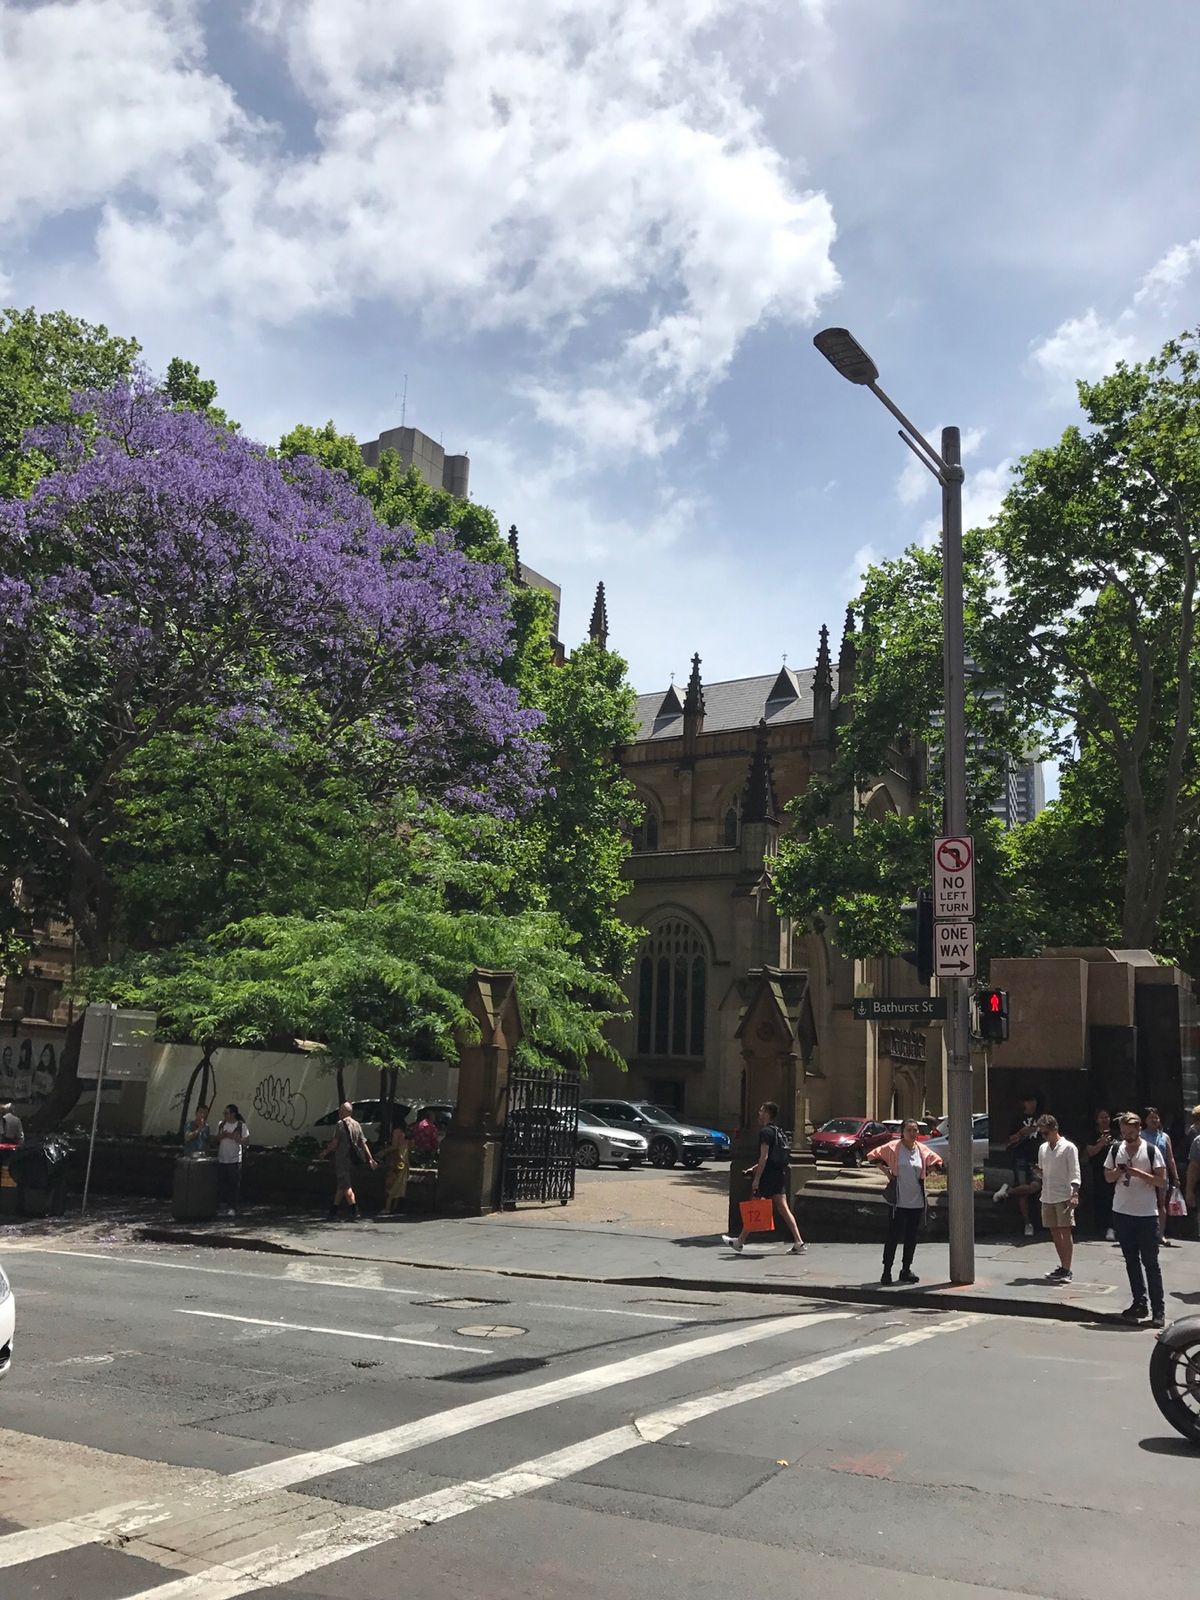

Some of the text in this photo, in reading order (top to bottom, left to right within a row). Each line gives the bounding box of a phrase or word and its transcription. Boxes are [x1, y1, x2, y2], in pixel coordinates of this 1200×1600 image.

[943, 877, 965, 889] NO
[940, 891, 967, 901] LEFT
[940, 903, 969, 912] TURN
[941, 928, 968, 940] ONE
[940, 944, 969, 957] WAY
[873, 1001, 934, 1013] Bathurst St
[747, 1210, 761, 1223] T2
